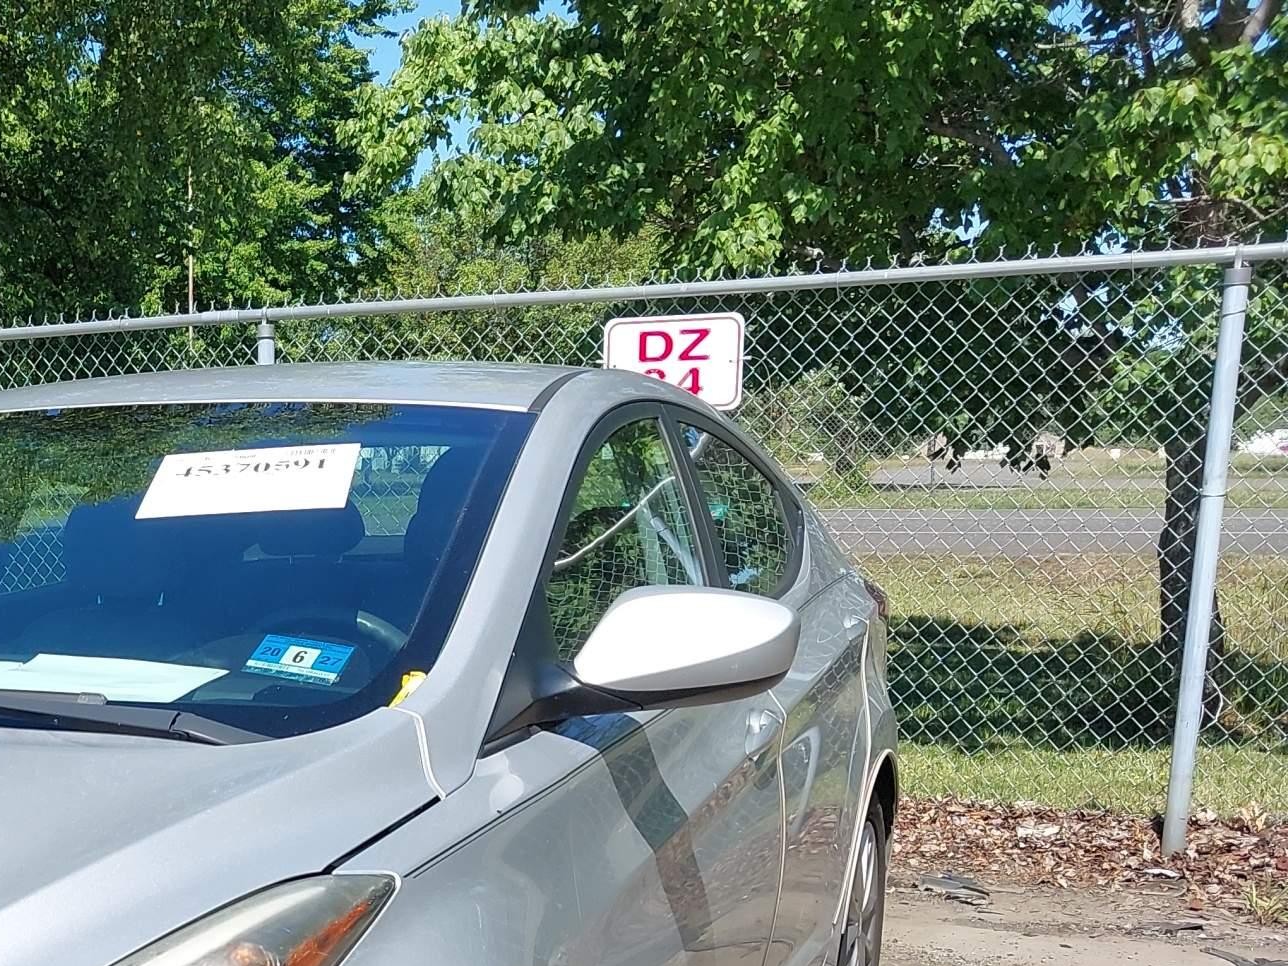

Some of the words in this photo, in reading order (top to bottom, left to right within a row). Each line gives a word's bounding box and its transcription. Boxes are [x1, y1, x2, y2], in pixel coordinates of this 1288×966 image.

[638, 328, 711, 363] DZ
[260, 646, 282, 657] 20
[292, 650, 308, 664] 6
[319, 655, 343, 666] 27
